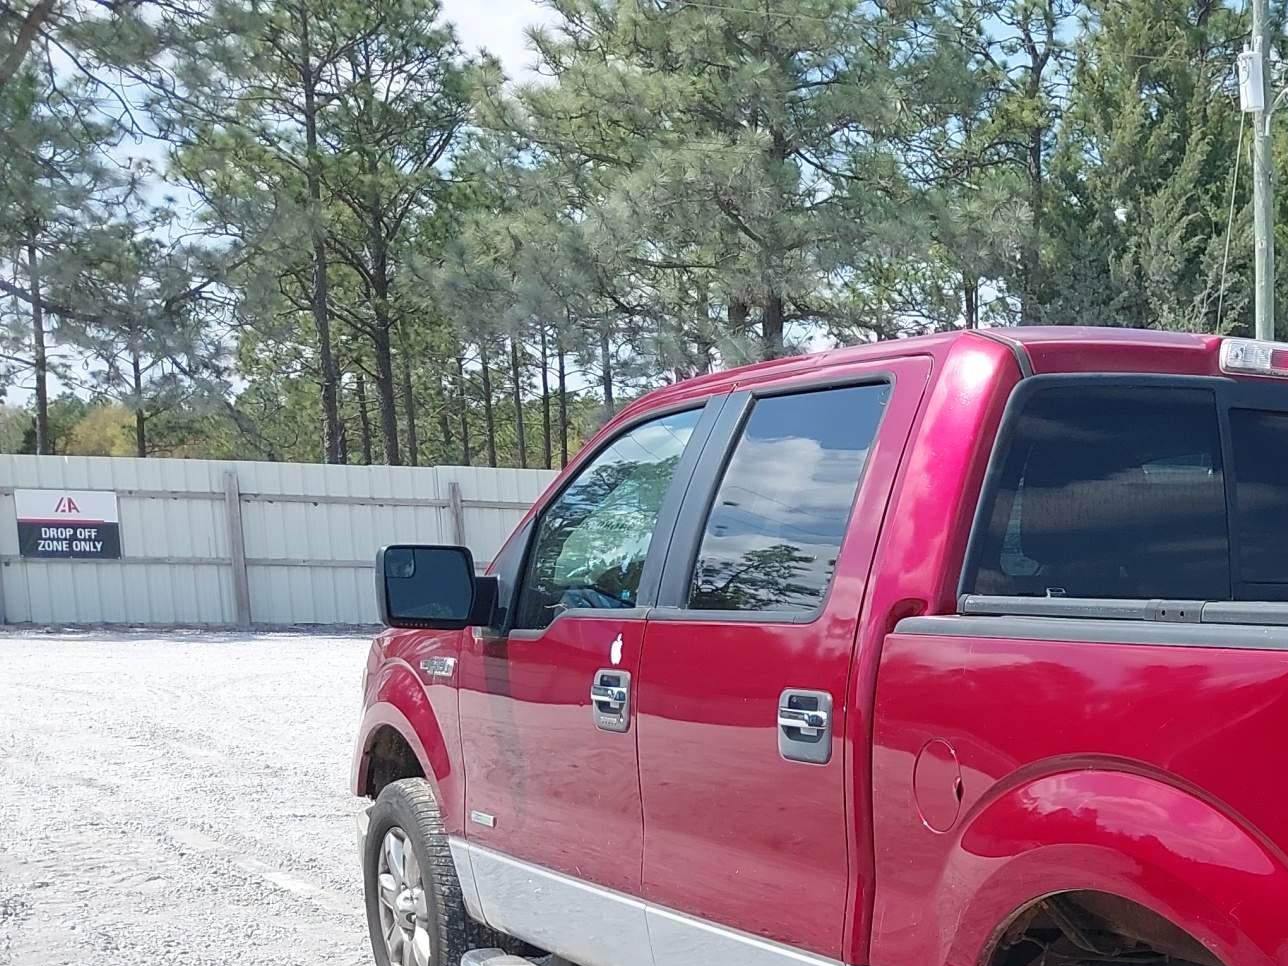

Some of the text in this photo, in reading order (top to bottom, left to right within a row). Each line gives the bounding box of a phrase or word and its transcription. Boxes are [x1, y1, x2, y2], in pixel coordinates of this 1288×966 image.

[41, 527, 97, 539] DROP OFF
[37, 540, 103, 552] ZONE ONLY
